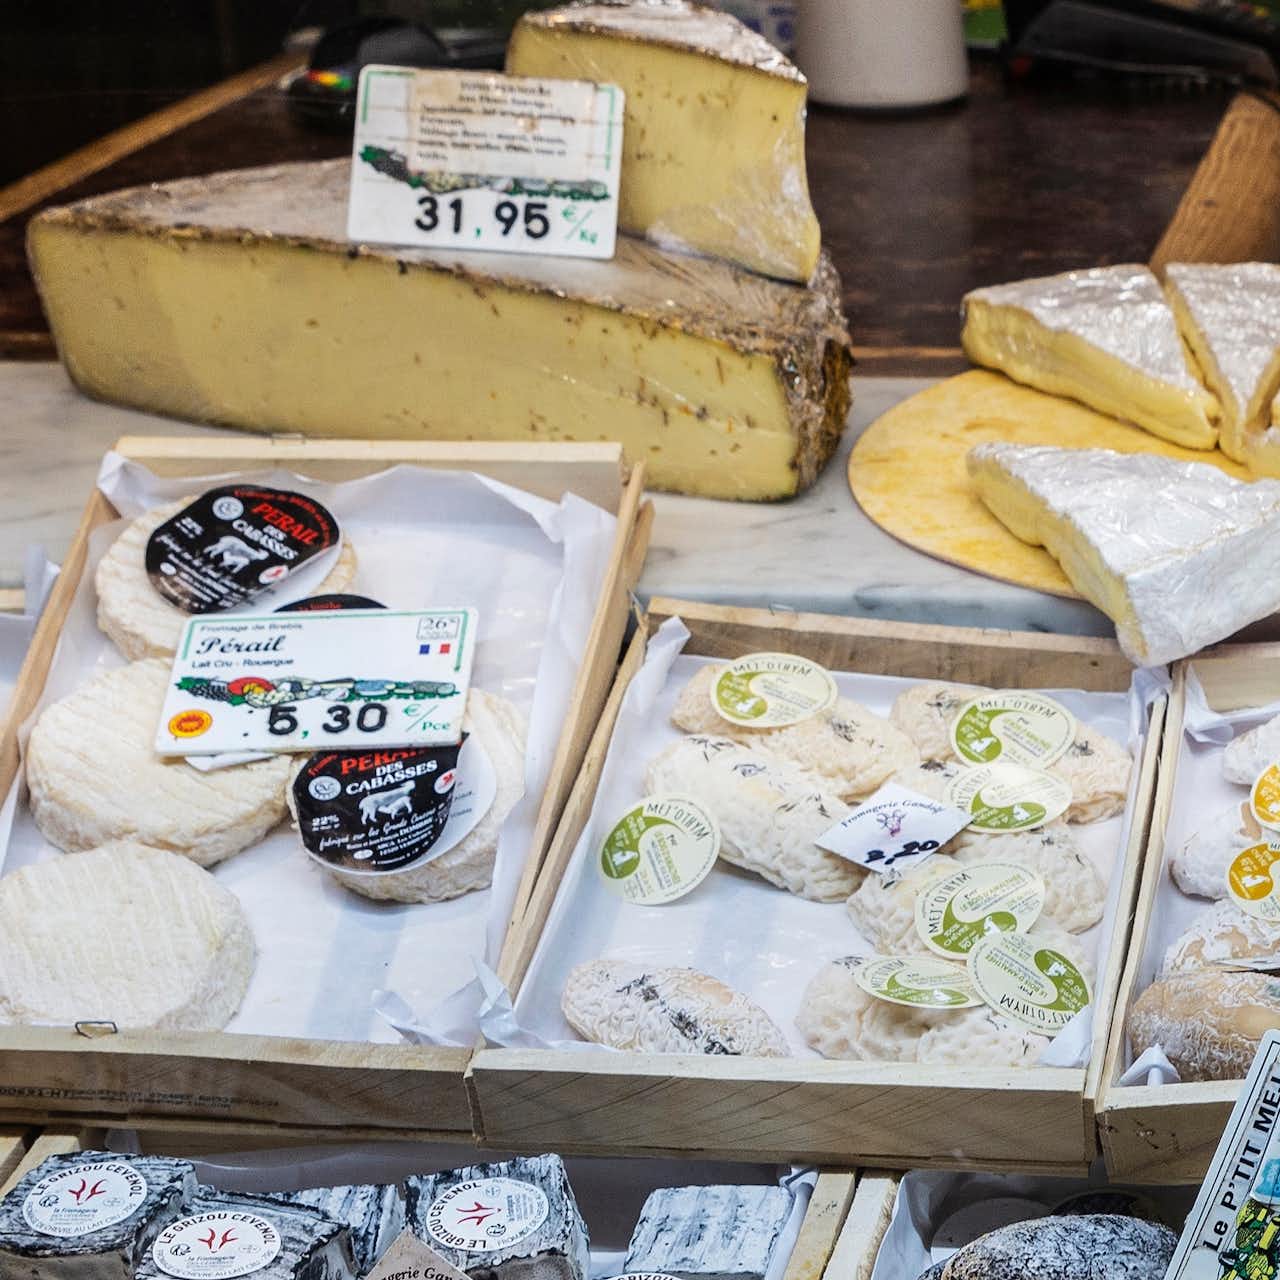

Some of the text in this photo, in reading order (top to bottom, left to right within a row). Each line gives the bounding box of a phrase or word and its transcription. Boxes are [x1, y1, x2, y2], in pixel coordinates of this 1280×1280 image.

[415, 195, 551, 239] 31,95
[196, 636, 286, 654] Pérail
[268, 703, 388, 739] 5,30
[346, 760, 438, 795] CABASSES
[376, 761, 403, 777] DES
[840, 801, 898, 829] Fromagerie
[32, 1163, 143, 1198] LE GRIZOU CEVENOL
[1203, 1222, 1229, 1252] Le
[1225, 1139, 1262, 1210] P'TIT
[159, 1212, 276, 1246] LE GRIZOU CEVENOL
[429, 1181, 488, 1250] LE GRIZOU CEVENOL
